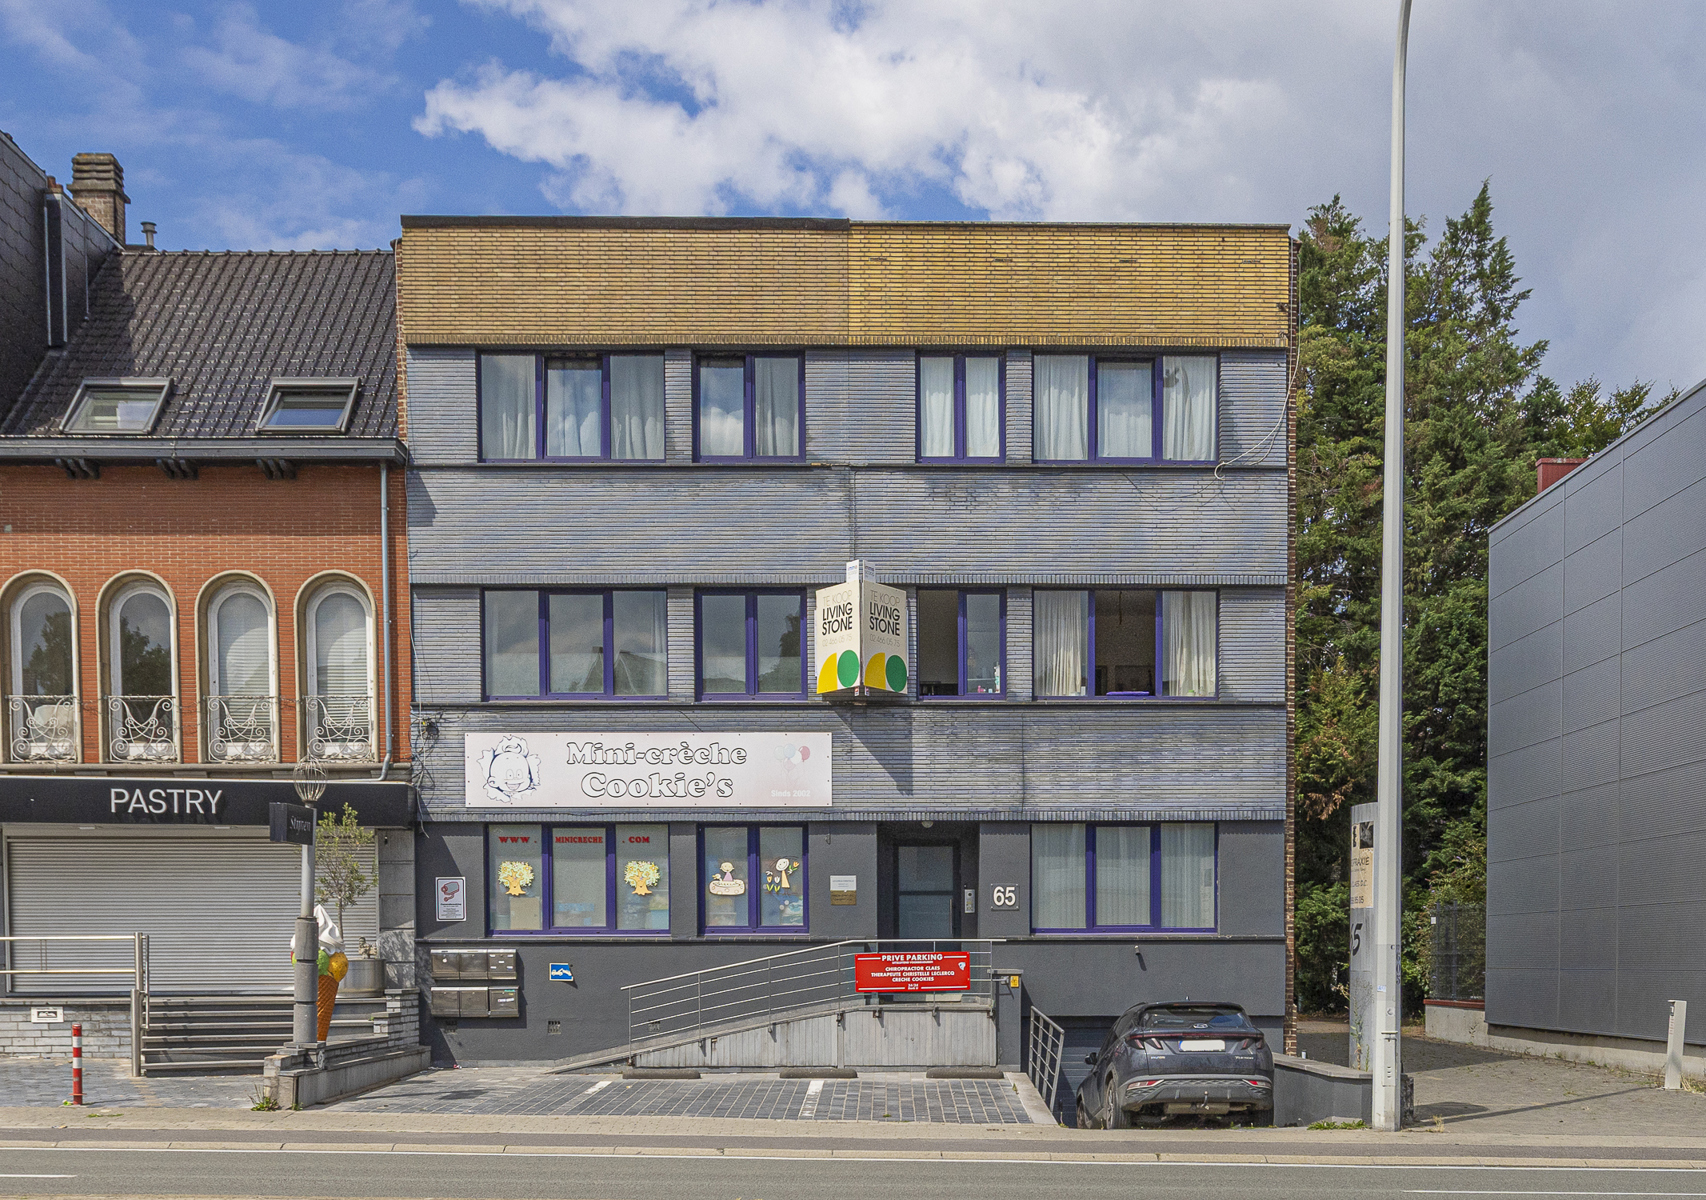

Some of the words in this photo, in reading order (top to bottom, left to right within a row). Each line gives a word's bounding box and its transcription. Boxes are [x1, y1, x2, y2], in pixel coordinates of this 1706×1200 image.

[823, 596, 831, 606] TE
[832, 590, 852, 604] KOOP
[870, 590, 878, 601] TE
[880, 591, 900, 606] KOOP
[822, 602, 853, 621] LIVING
[869, 602, 900, 621] LIVING
[822, 615, 853, 636] STONE
[869, 616, 900, 637] STONE
[566, 742, 747, 765] Mini-crèche
[581, 771, 733, 798] Cookie's
[771, 789, 791, 797] Sinds
[793, 789, 811, 797] 2002
[110, 788, 222, 814] PASTRY
[555, 836, 603, 844] MINICRECHE
[993, 886, 1016, 906] 65
[882, 954, 905, 962] PRIVE
